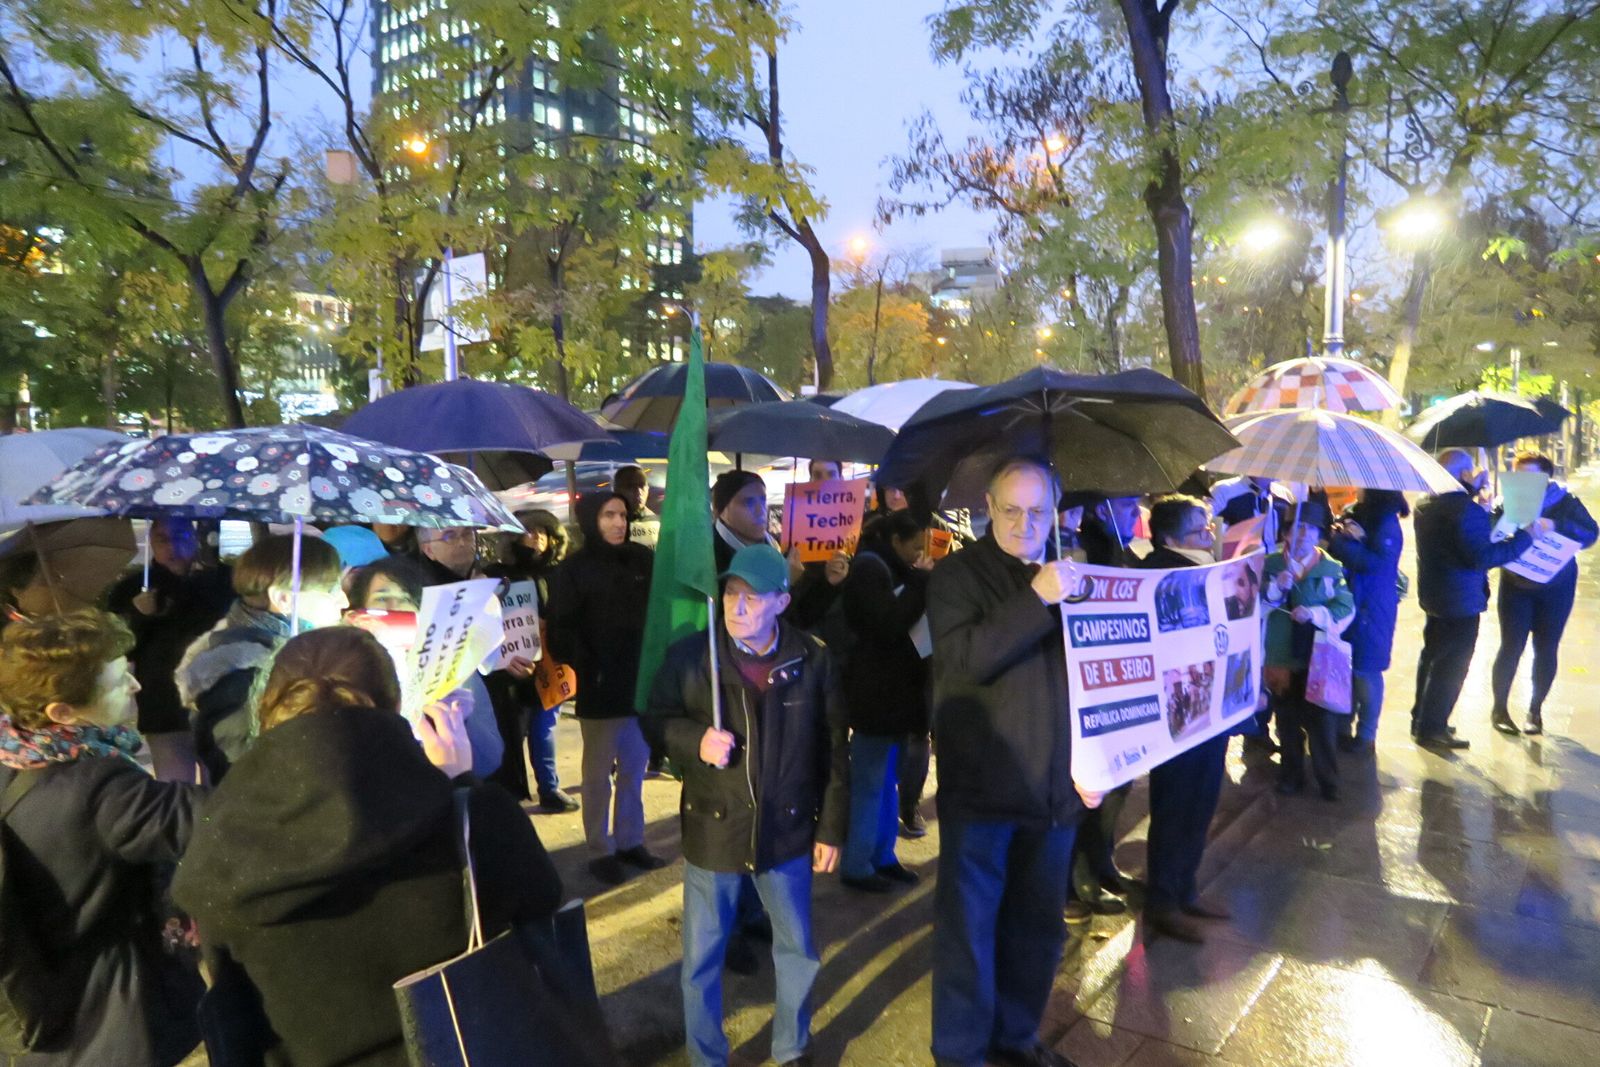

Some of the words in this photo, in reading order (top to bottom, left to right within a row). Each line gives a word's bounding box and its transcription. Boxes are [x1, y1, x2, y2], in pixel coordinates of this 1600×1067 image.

[805, 491, 857, 505] Tierra,
[807, 513, 854, 529] Techo
[516, 592, 531, 608] por
[1112, 580, 1137, 599] LOS
[1074, 619, 1148, 642] CAMPESINOS
[500, 640, 519, 658] por
[521, 635, 531, 649] la
[1084, 663, 1100, 686] DE
[1104, 661, 1118, 683] EL
[1121, 657, 1152, 680] SEIBO
[1083, 709, 1121, 730] REPÚBLICA
[1120, 701, 1160, 721] DOMINICANA
